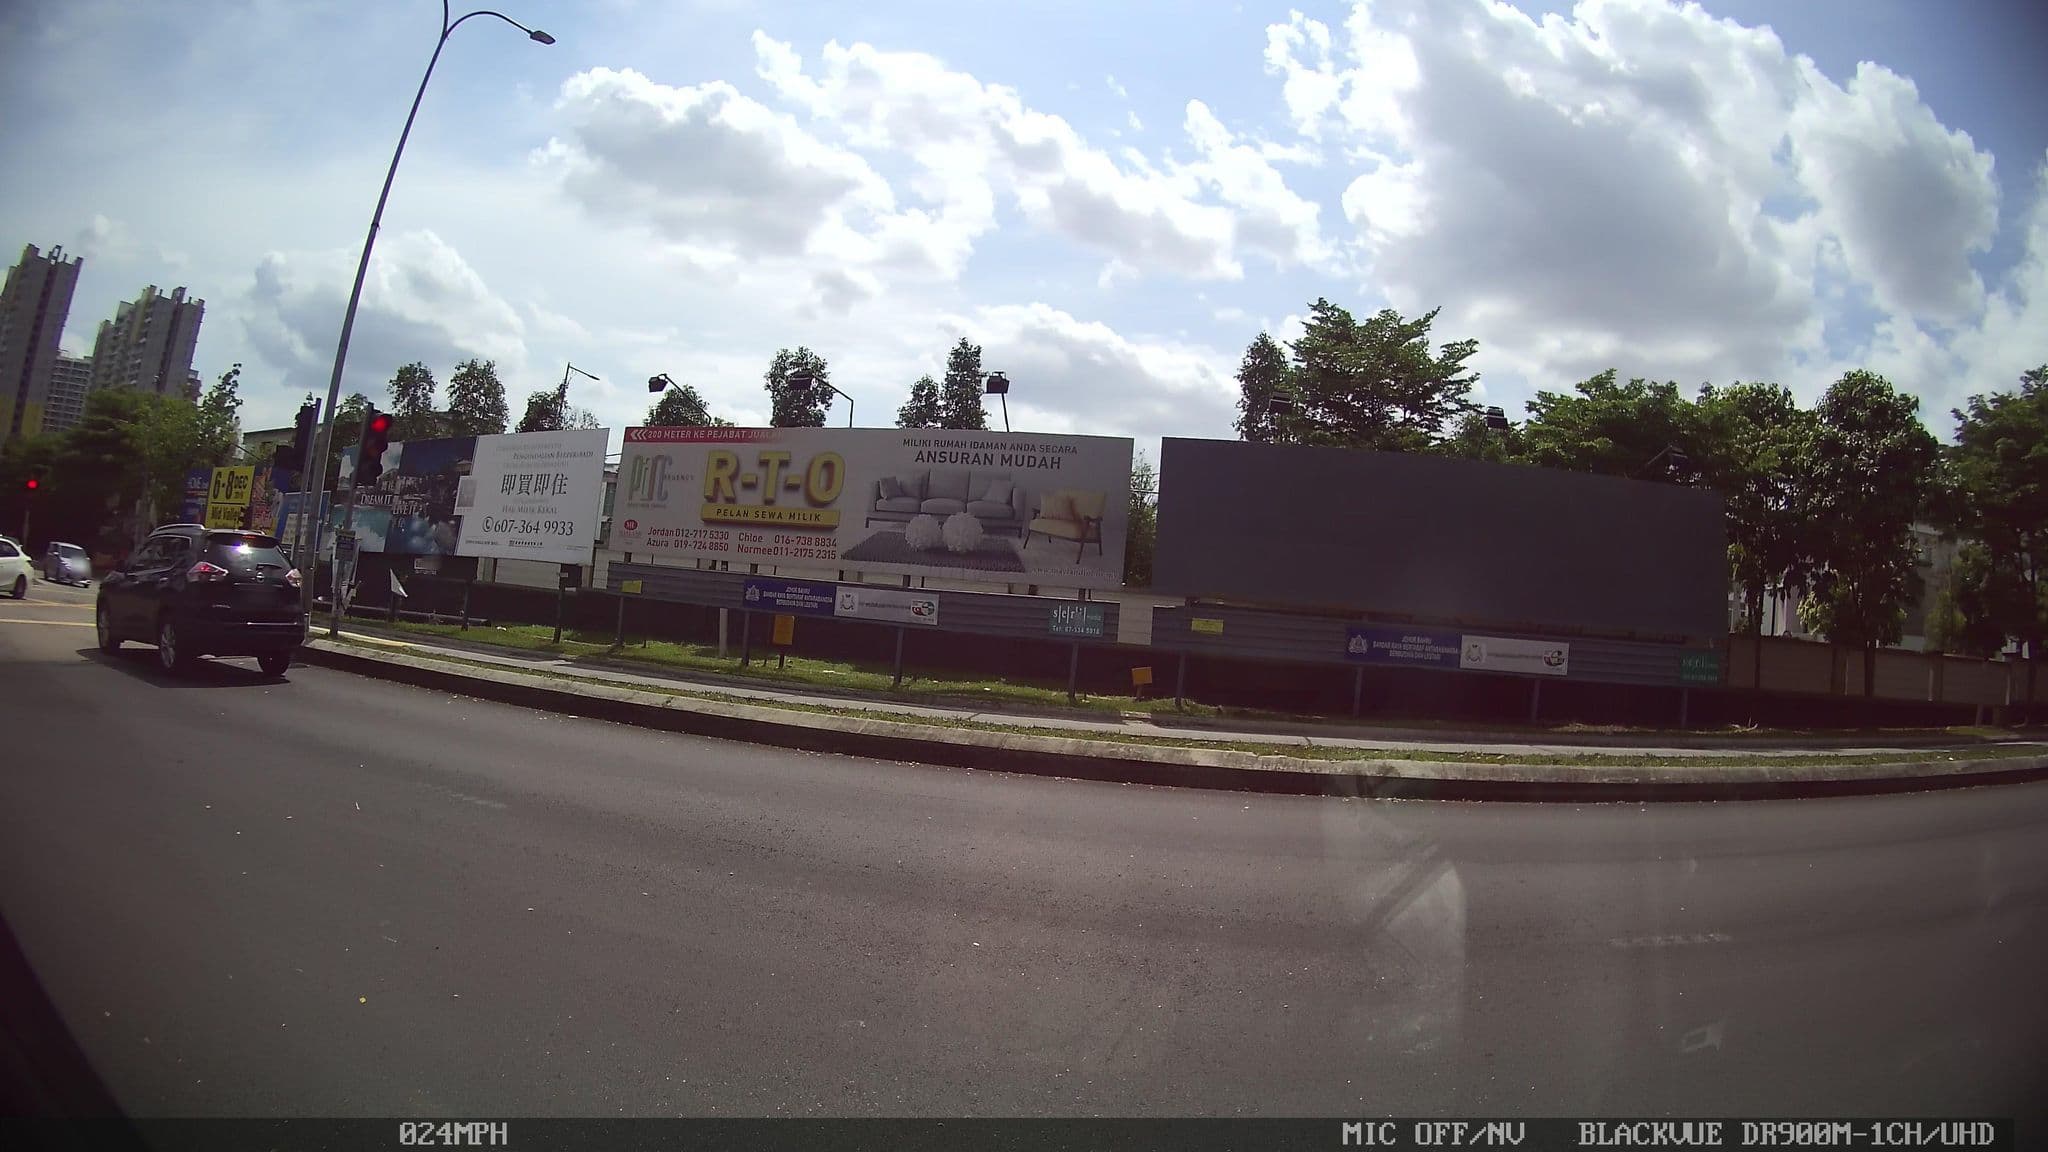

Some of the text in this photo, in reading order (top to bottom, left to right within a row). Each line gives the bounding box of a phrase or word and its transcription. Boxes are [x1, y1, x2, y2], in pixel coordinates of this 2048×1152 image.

[648, 431, 663, 439] 200
[664, 431, 692, 439] METER
[694, 431, 705, 439] KE
[706, 431, 747, 439] PEJABAT
[903, 438, 1078, 455] MILIKI RUMAH IDAMAN ANDA SECARA
[915, 450, 1061, 470] ANSURAN MUDAH
[234, 475, 249, 489] DEC
[501, 473, 568, 497] 即買即住
[704, 450, 846, 507] R-T-O
[360, 493, 393, 505] DREAM IT
[716, 508, 822, 522] PELAN SEWA MILIK
[494, 519, 575, 537] 607-364 9933
[647, 527, 675, 538] Jordan
[675, 528, 707, 540] 012-717
[709, 529, 730, 541] 5330
[646, 537, 730, 552] Azura 019-724 8850
[738, 533, 838, 548] Chloe 016-738 8834
[737, 544, 773, 556] Normee
[815, 549, 838, 560] 2315
